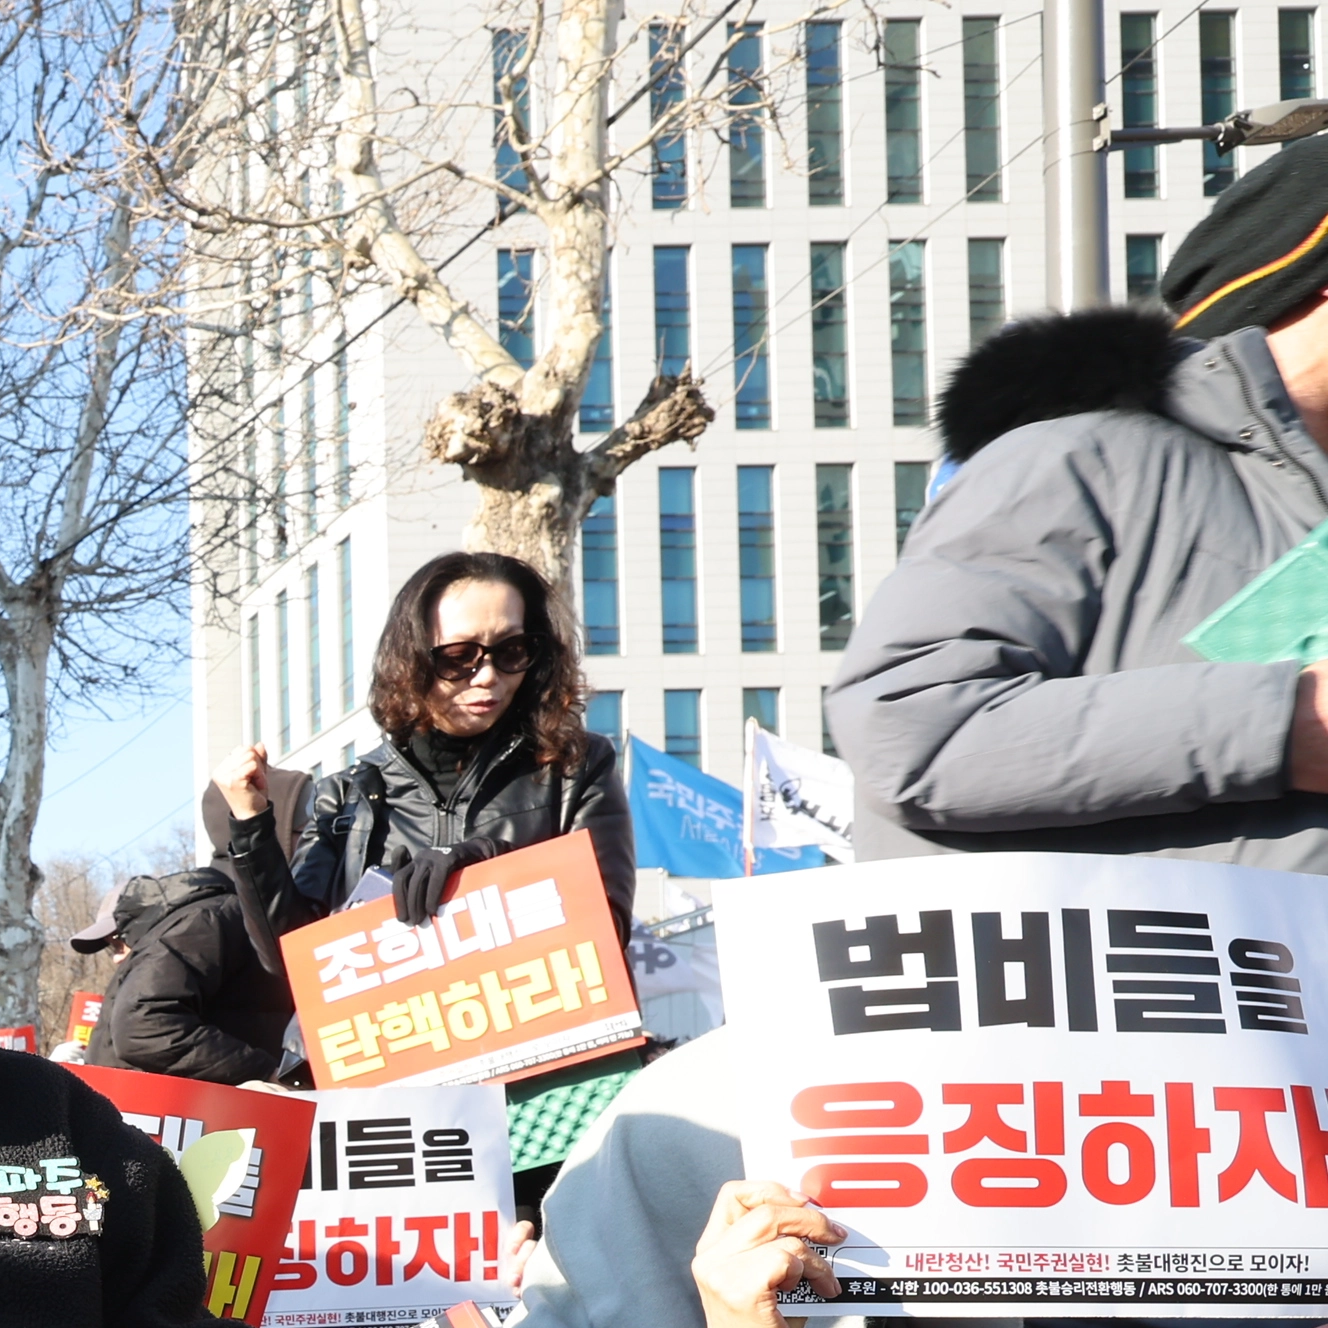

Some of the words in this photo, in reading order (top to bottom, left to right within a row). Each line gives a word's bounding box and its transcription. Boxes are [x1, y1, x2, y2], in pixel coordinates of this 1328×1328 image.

[313, 878, 567, 1003] 조희대를
[812, 907, 1309, 1036] 법비들을
[317, 940, 606, 1083] 탄핵하라!
[270, 1210, 498, 1292] 징하자!
[847, 1282, 876, 1297] 후원
[890, 1282, 919, 1297] 신한
[922, 1281, 1032, 1297] 100-036-551308
[1035, 1281, 1136, 1297] 촛불승리전환행동
[1147, 1282, 1174, 1297] ARS
[1280, 1283, 1303, 1297] 통에
[1304, 1283, 1323, 1297] 1만
[904, 1252, 990, 1273] 내란청산!
[996, 1252, 1111, 1273] 국민주권실현!
[1116, 1252, 1244, 1273] 촛불대행진으로
[1249, 1253, 1310, 1274] 모이자!
[275, 1313, 342, 1326] 국민주권실현!
[345, 1308, 417, 1323] 촛불대행진으로
[421, 1305, 447, 1320] 모이
